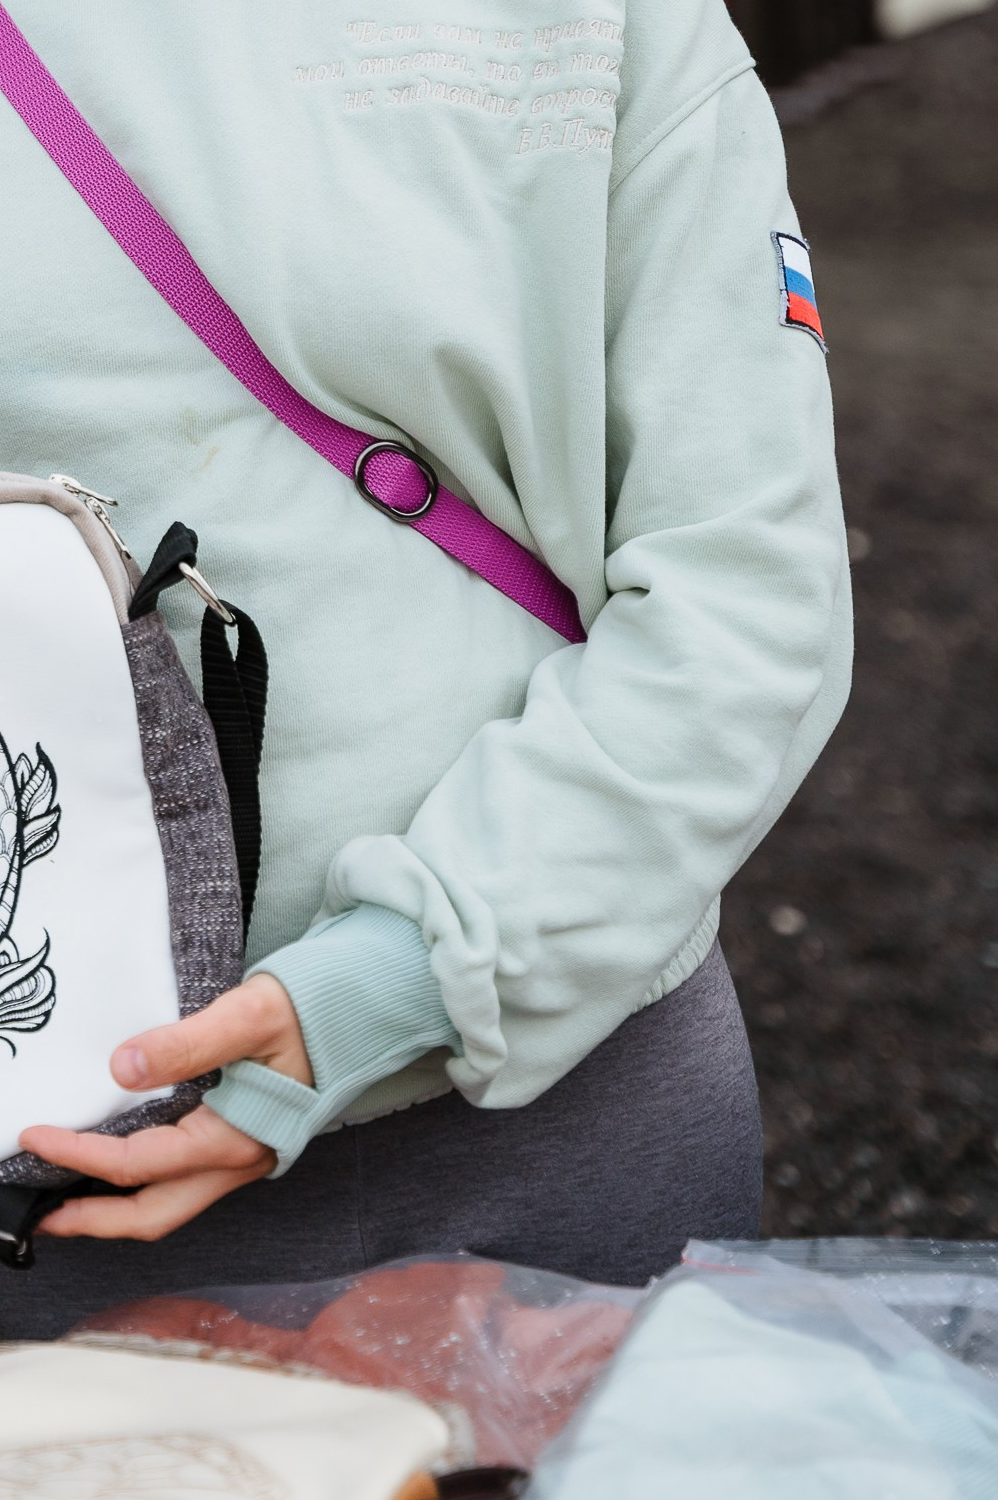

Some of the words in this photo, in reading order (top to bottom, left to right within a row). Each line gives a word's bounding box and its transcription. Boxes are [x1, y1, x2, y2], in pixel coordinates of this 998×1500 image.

[495, 28, 524, 49] не
[534, 19, 624, 52] нравят
[486, 60, 523, 83] то
[569, 53, 620, 77] тог
[343, 89, 375, 112] не
[531, 87, 617, 114] вопрос
